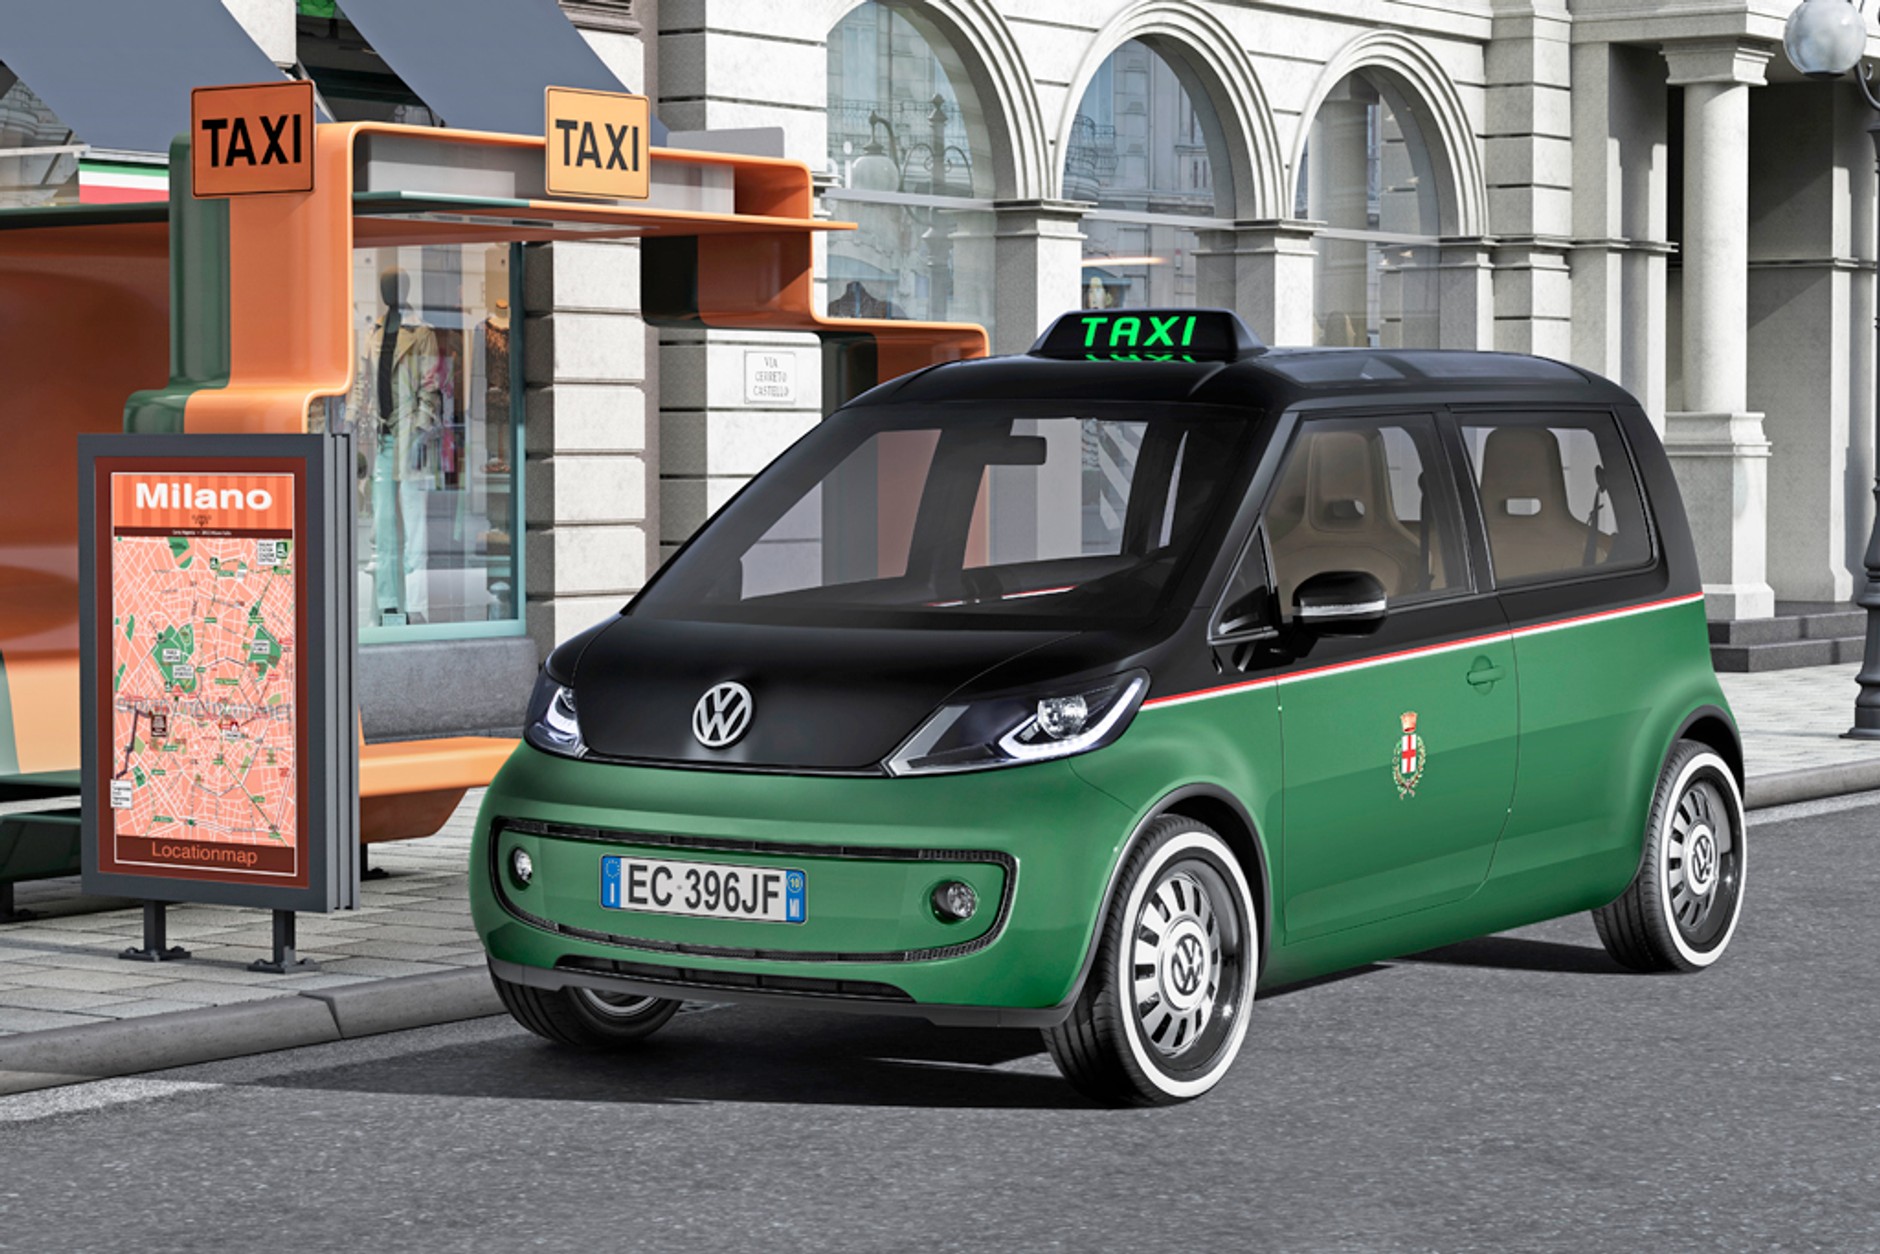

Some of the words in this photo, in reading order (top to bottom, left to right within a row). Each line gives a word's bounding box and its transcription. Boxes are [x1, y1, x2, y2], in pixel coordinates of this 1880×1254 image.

[202, 114, 301, 167] TAXI
[555, 119, 638, 172] TAXI
[1081, 315, 1197, 347] TAXI
[763, 356, 778, 368] VIA
[754, 370, 787, 383] CERRETO
[752, 385, 789, 397] CASTELLO
[135, 482, 272, 510] Milano
[152, 841, 258, 867] Locationmap
